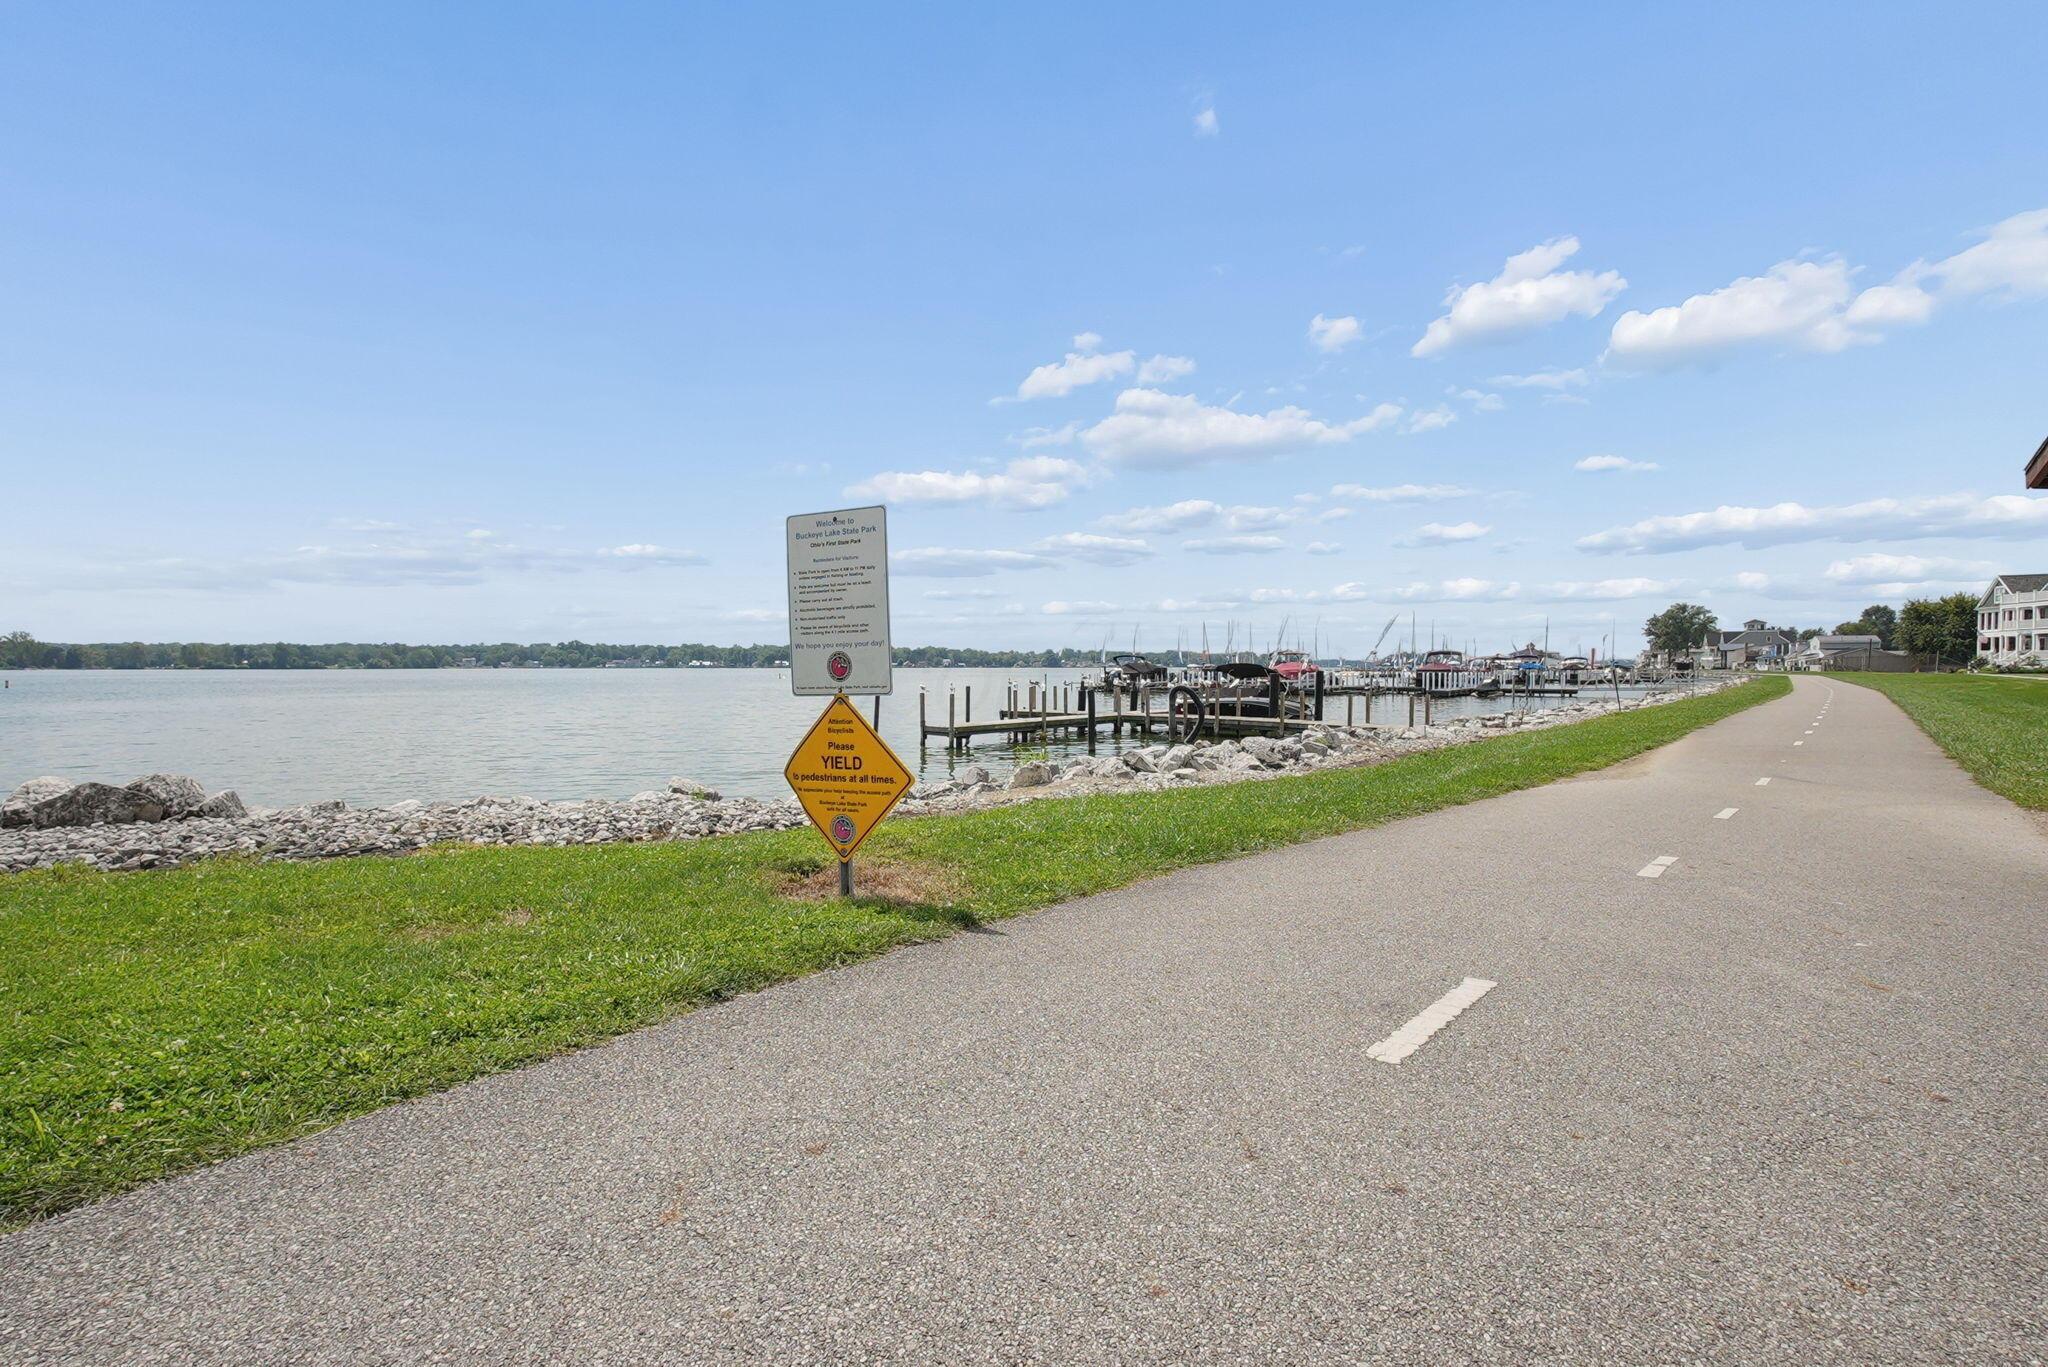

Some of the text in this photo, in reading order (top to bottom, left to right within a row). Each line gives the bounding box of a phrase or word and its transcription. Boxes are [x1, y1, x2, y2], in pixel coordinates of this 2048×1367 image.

[816, 519, 845, 527] Welcome
[828, 742, 855, 750] Please
[821, 756, 862, 770] YIELD
[801, 773, 847, 782] pedestrians
[859, 775, 868, 783] all
[871, 775, 896, 784] times.
